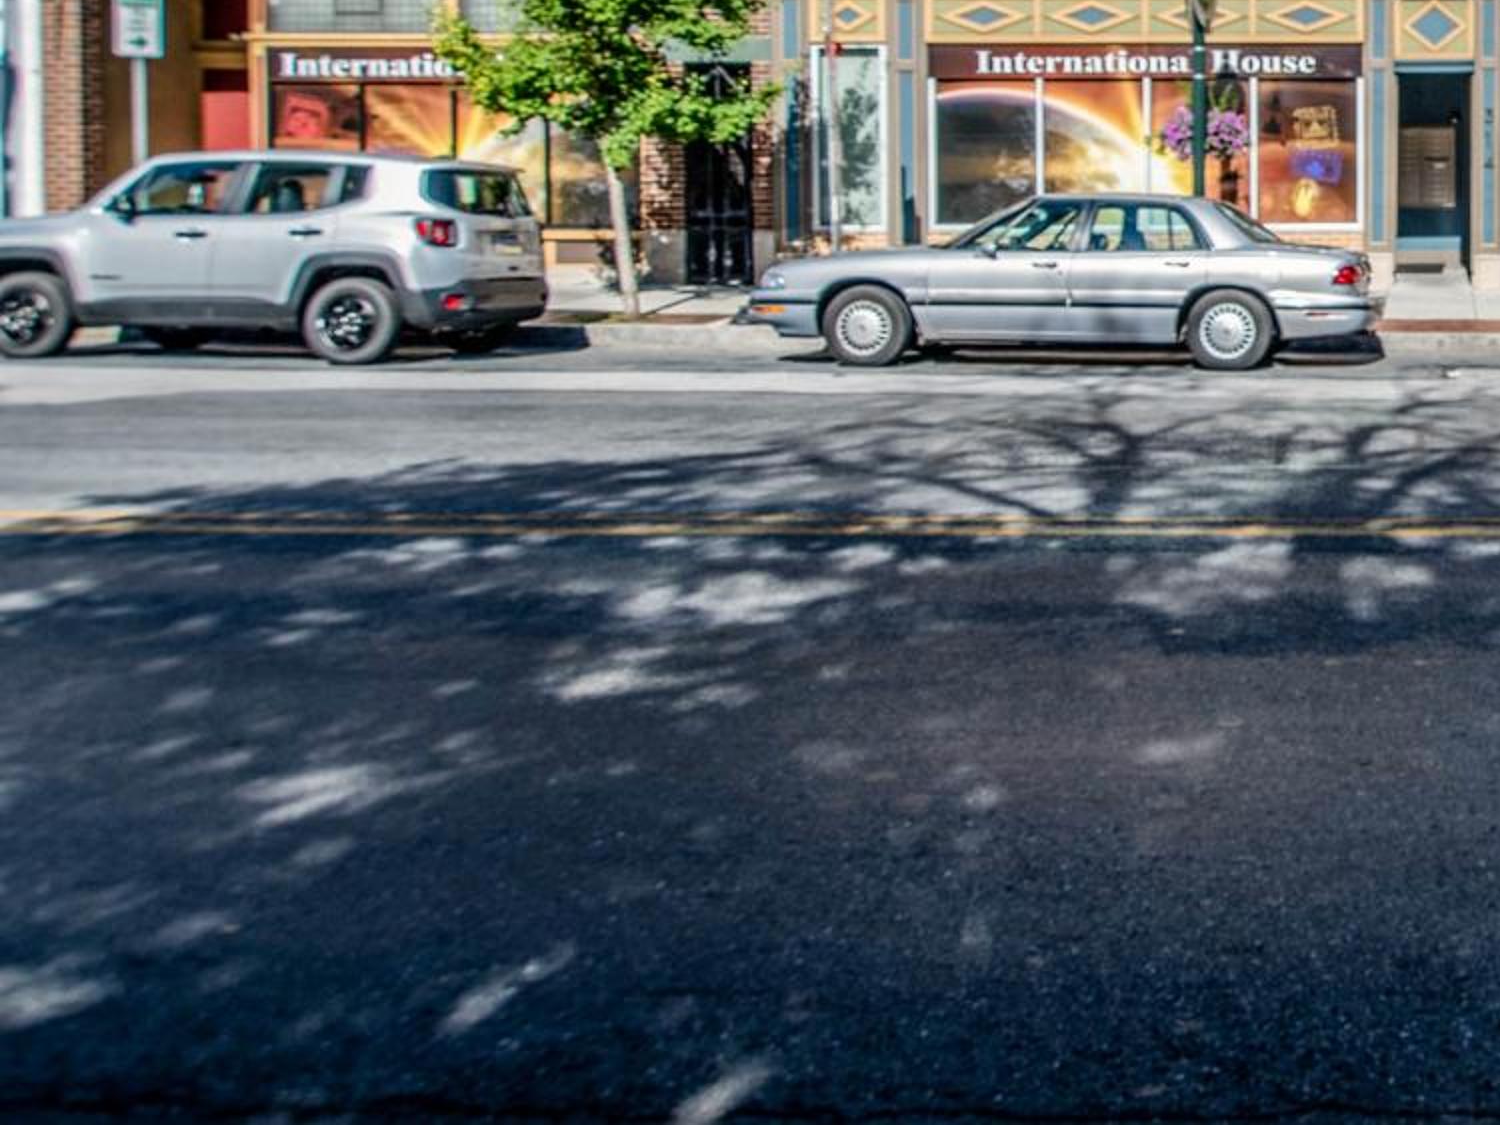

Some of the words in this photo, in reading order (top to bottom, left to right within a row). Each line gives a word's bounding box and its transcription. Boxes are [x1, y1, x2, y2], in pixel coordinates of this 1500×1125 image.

[279, 52, 458, 78] Internatio
[976, 50, 1191, 74] Internationa
[1211, 49, 1317, 74] House
